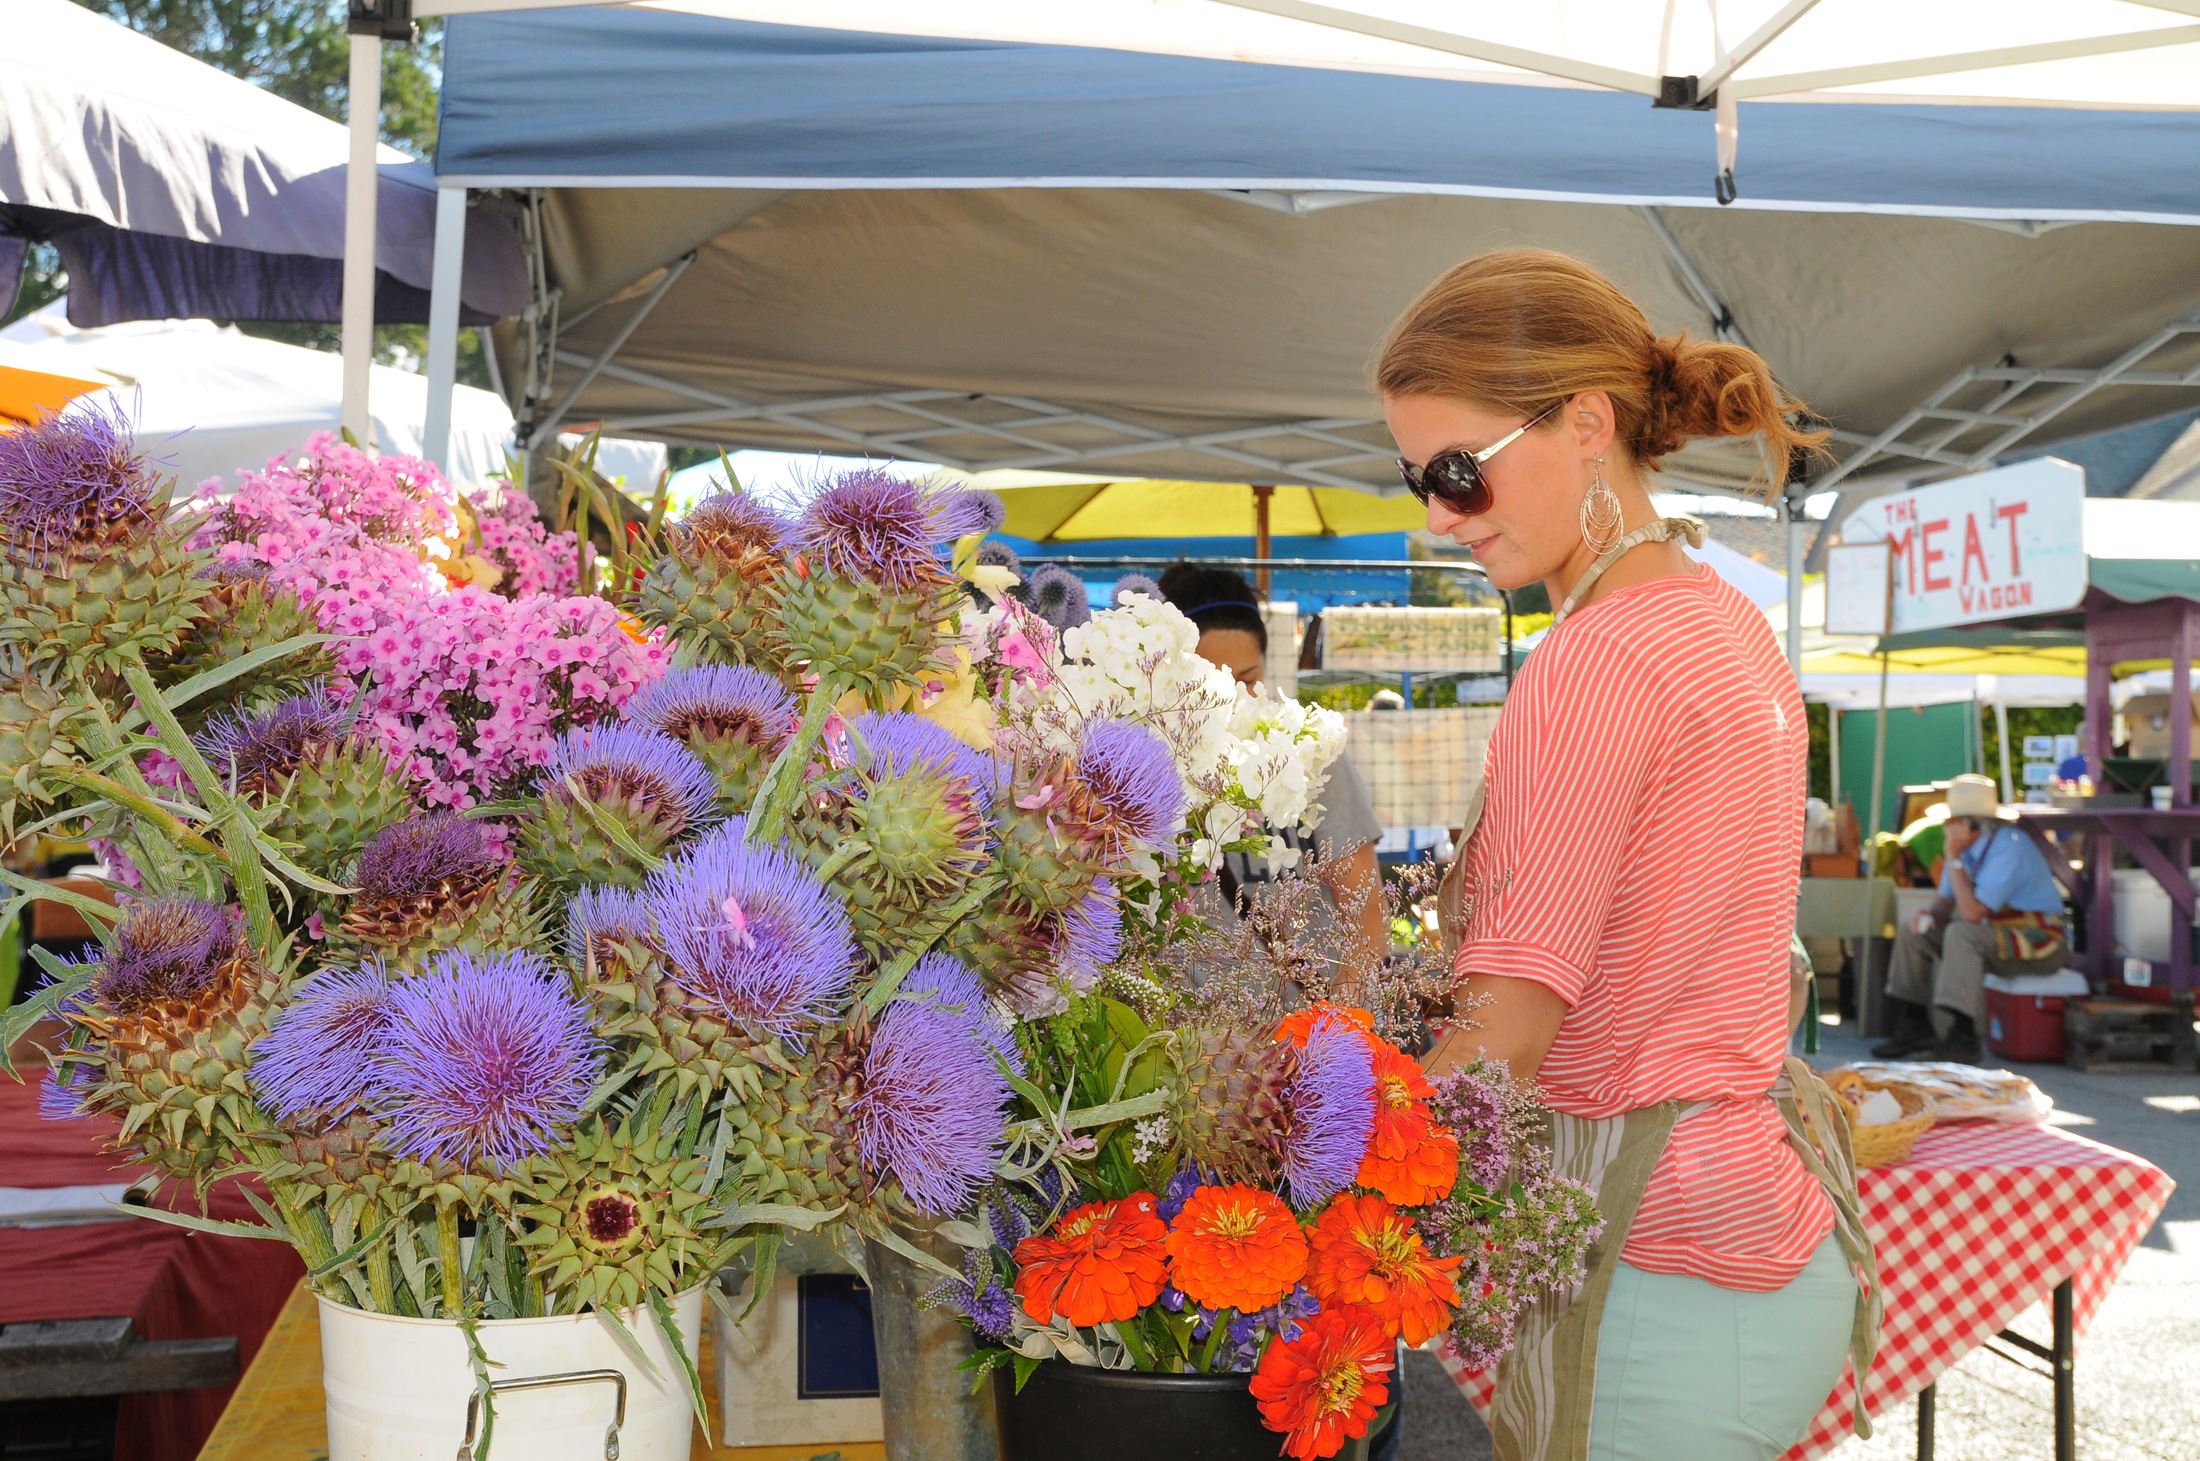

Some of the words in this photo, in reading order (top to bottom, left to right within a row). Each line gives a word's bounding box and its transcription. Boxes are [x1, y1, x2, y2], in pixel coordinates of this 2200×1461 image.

[1884, 497, 1917, 525] THE
[1886, 501, 2029, 595] MEAT
[1958, 581, 2033, 615] WAGON
